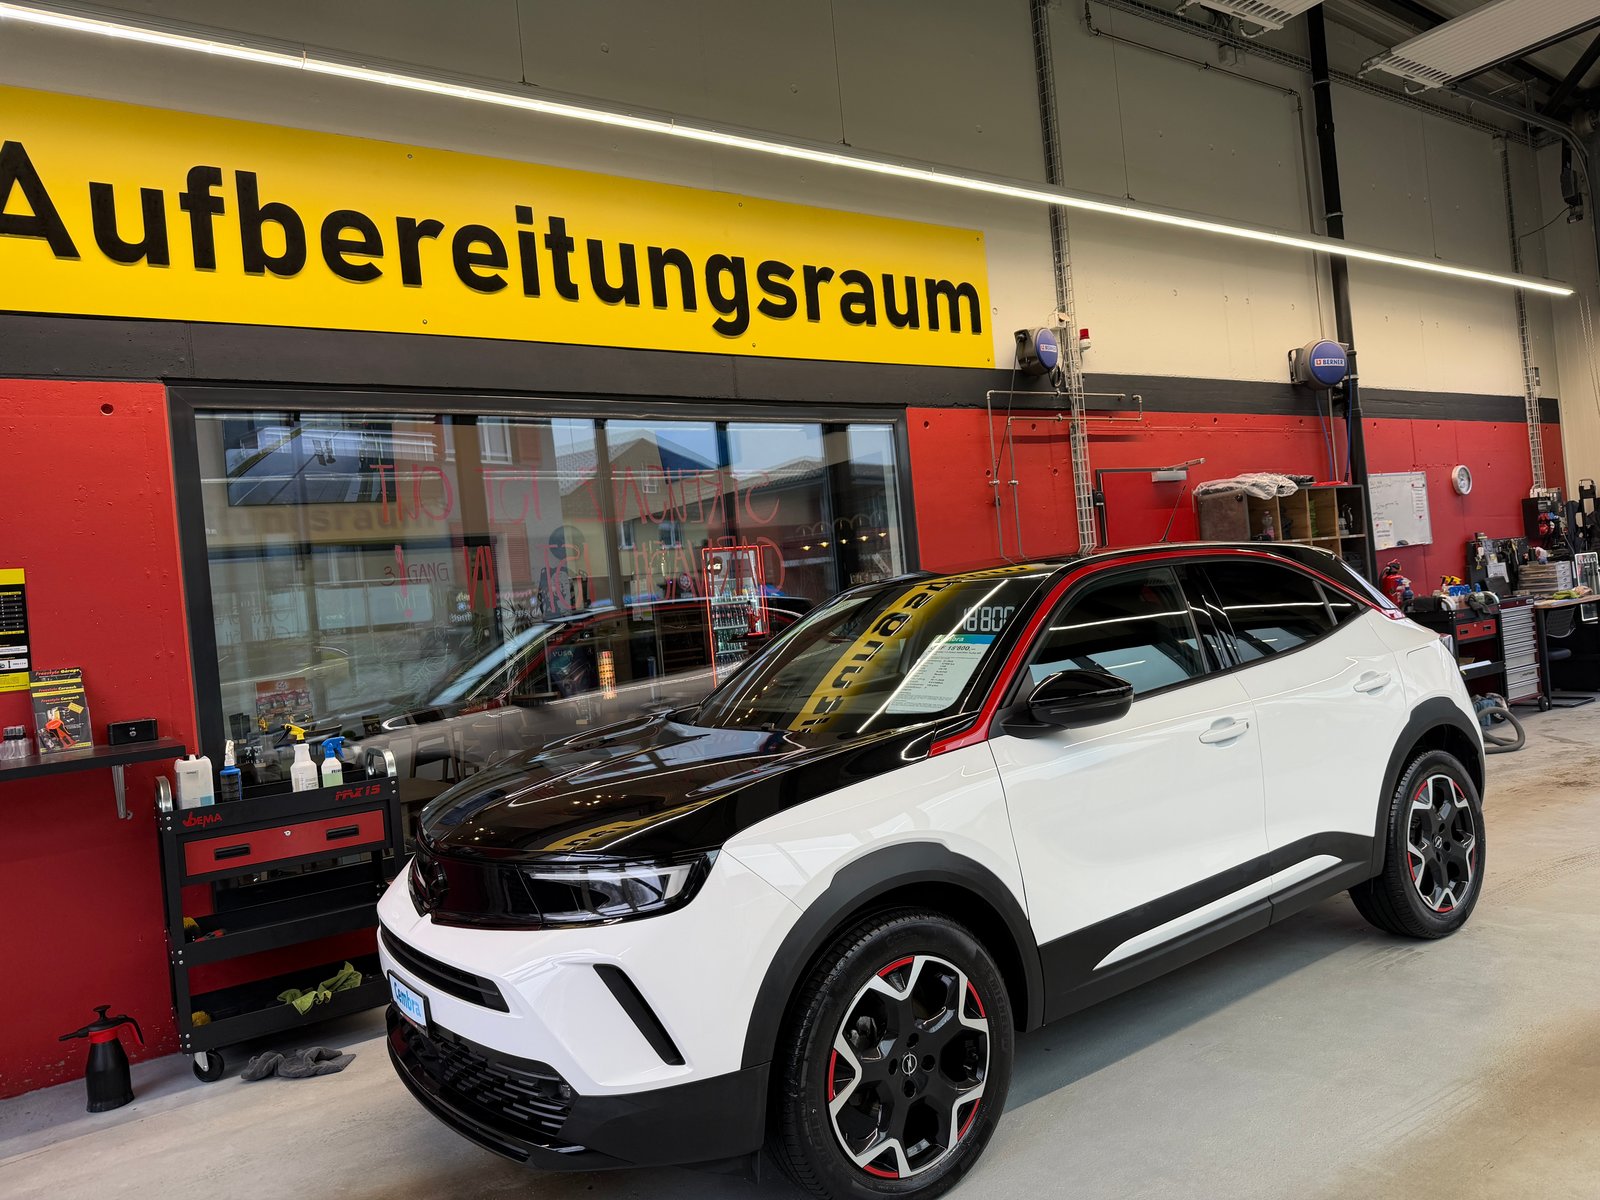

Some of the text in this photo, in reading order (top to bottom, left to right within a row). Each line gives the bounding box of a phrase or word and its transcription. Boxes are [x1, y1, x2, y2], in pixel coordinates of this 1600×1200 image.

[0, 141, 982, 336] Aufbereitungsraum
[1322, 358, 1345, 366] BERNER
[407, 562, 450, 585] GANG
[393, 981, 422, 1018] Cembra
